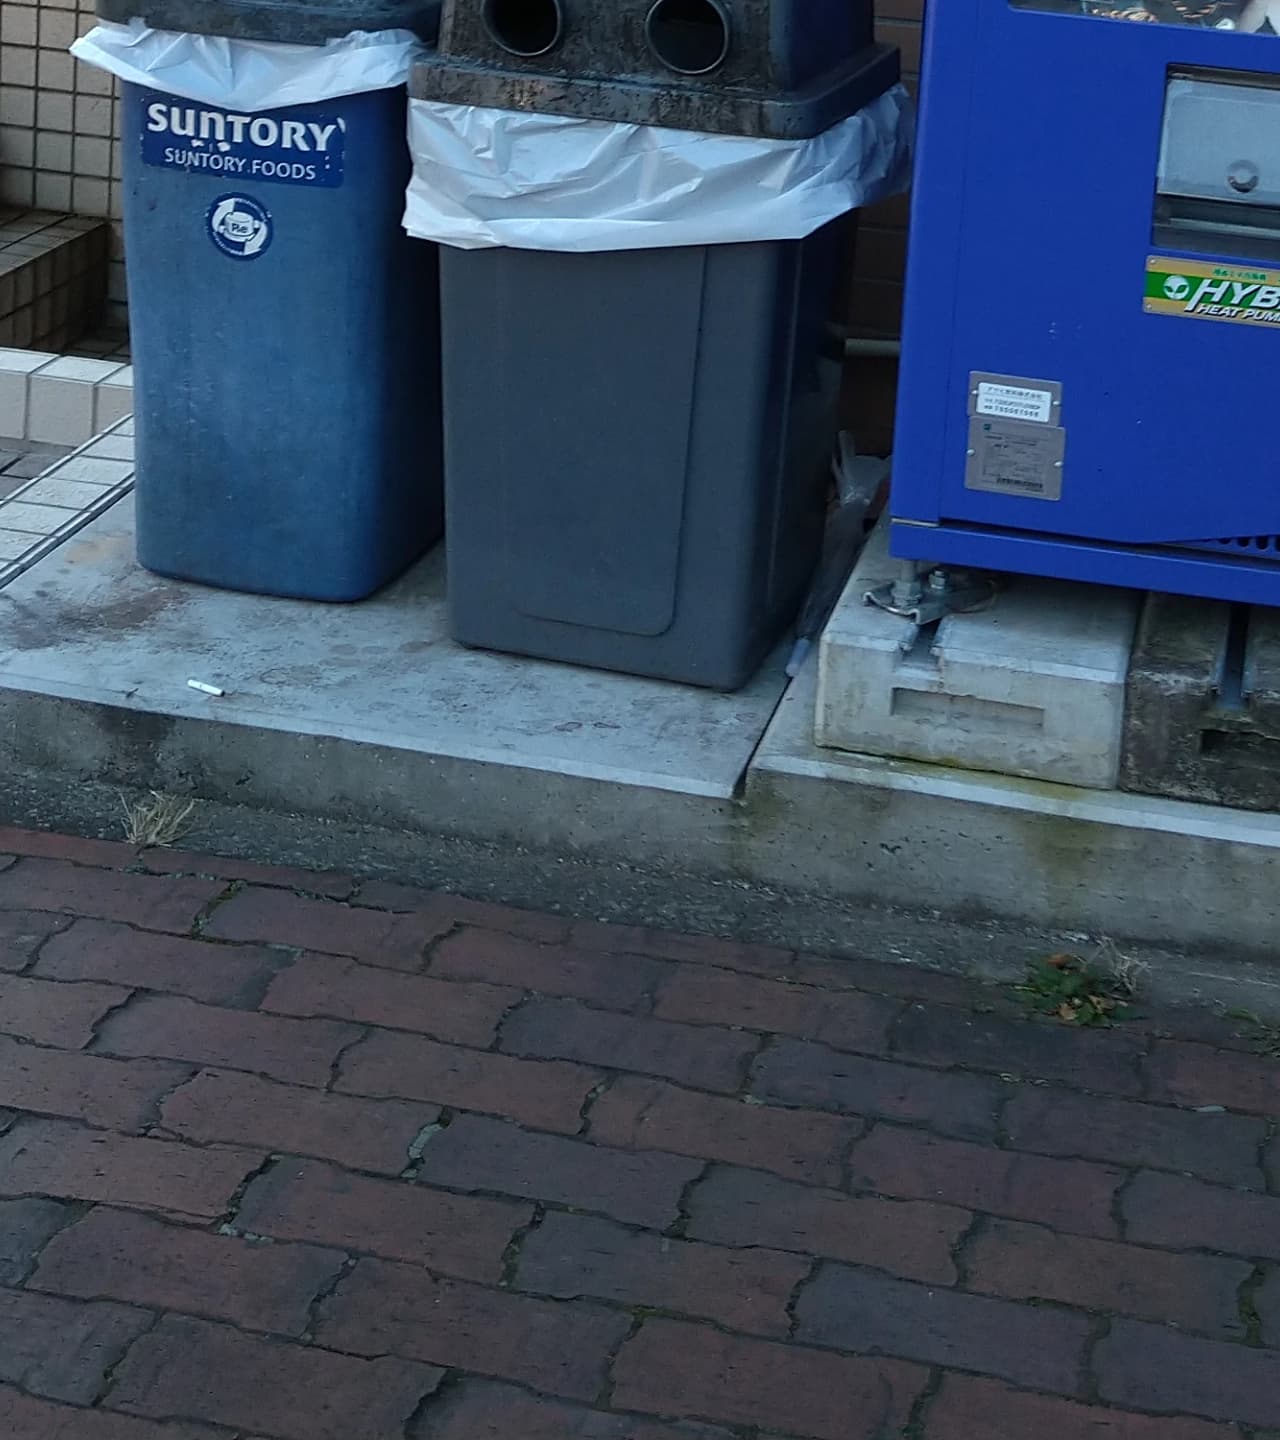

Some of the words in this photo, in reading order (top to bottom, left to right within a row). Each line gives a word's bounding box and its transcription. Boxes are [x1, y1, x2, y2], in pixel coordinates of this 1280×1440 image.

[164, 145, 246, 172] SUNTORY
[251, 156, 318, 182] FOODS
[1197, 303, 1243, 319] HEAT
